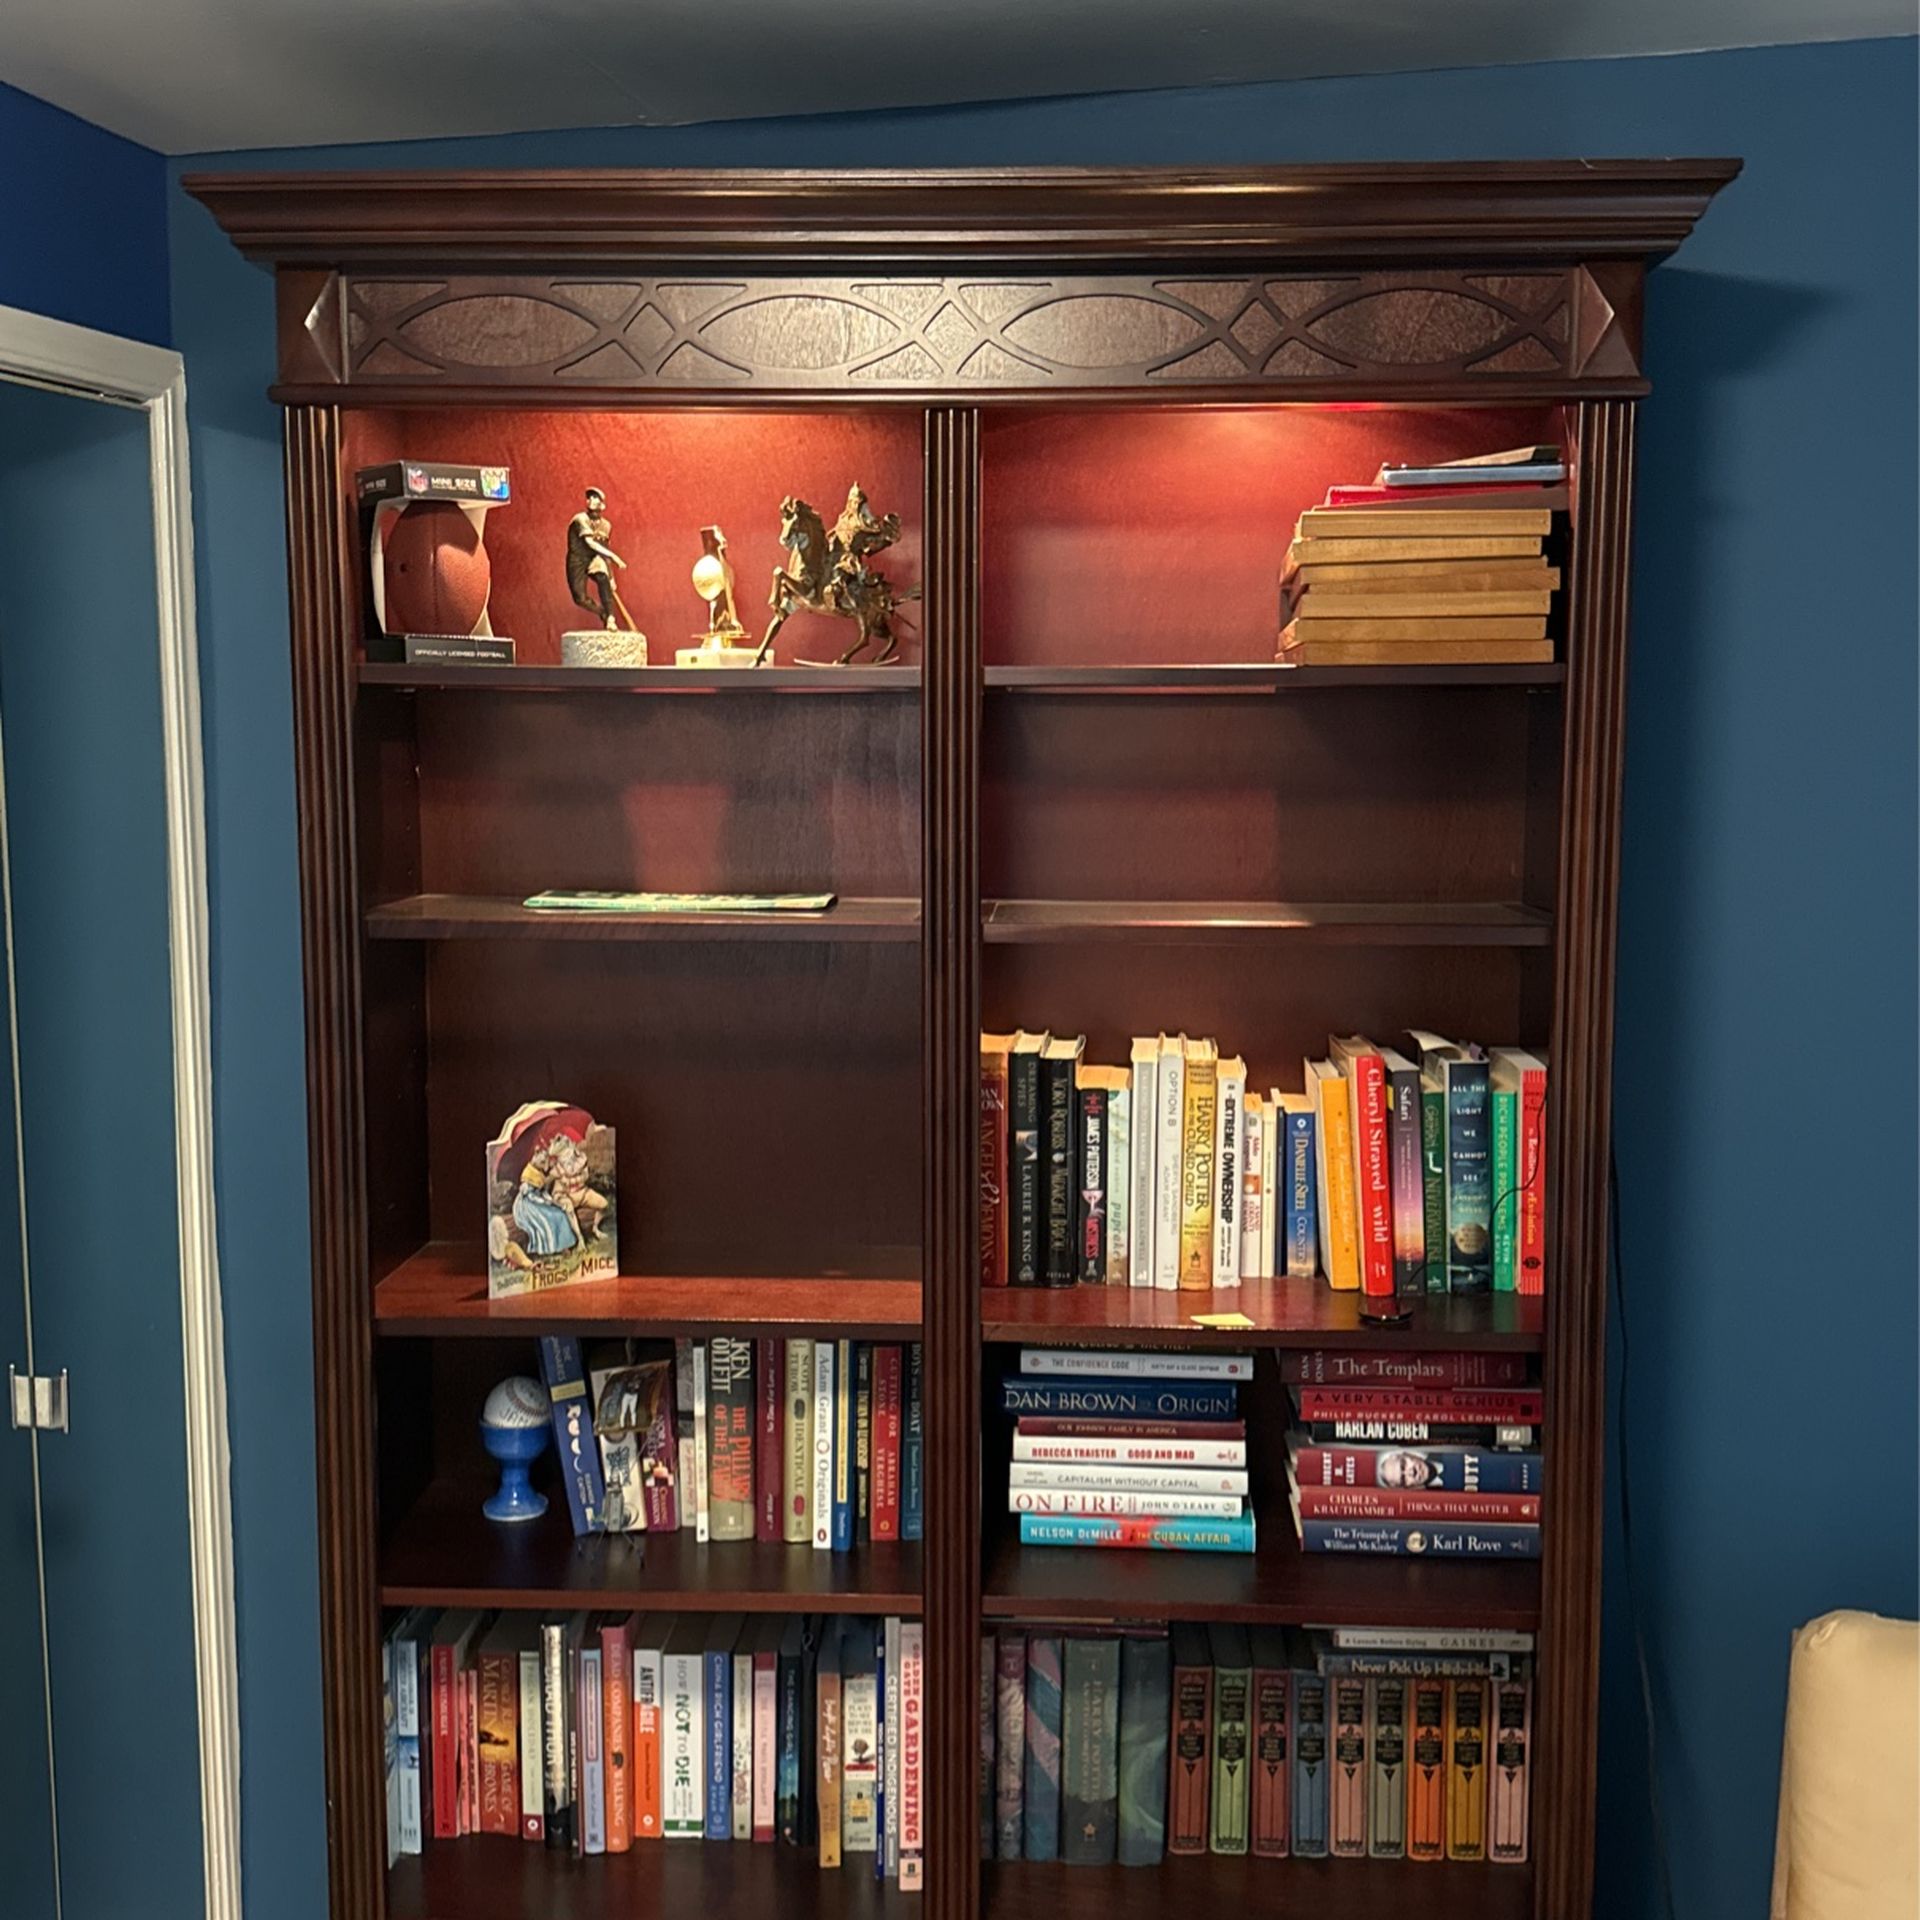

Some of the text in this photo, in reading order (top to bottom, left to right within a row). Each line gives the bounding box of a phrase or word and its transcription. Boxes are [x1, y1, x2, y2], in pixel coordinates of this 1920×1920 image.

[431, 477, 477, 490] MINI SIZE
[1018, 1078, 1026, 1108] SPIES
[1027, 1061, 1037, 1123] DREAMING
[1167, 1070, 1178, 1126] OPTION B
[1400, 1086, 1412, 1121] Safari
[1050, 1077, 1068, 1149] NORA ROBERTS
[1197, 1096, 1213, 1149] HARRY
[1224, 1098, 1236, 1149] EXTREME
[1456, 1107, 1482, 1115] LIGHT
[1366, 1067, 1386, 1192] Cheryl Strayed
[1086, 1115, 1100, 1190] JAMES PATTERSON
[1184, 1128, 1196, 1207] CURSED CHILD
[1497, 1096, 1509, 1231] RICH PEOPLE PROBLEMS
[1195, 1152, 1212, 1212] POTTER
[1221, 1152, 1235, 1224] OWNERSHIP
[1294, 1138, 1310, 1211] DANIELLE STEEL
[1463, 1174, 1478, 1182] SEE
[1022, 1164, 1032, 1262] LAURIE KING
[1373, 1205, 1388, 1243] wild
[1295, 1216, 1308, 1265] COUNTRY
[532, 1266, 569, 1290] FROGS
[731, 1338, 751, 1379] KEN
[790, 1353, 799, 1393] TUROW
[800, 1353, 809, 1392] SCOTT
[1052, 1359, 1130, 1370] THE CONFIDENCE CODE
[1301, 1354, 1309, 1379] DAN
[1332, 1358, 1369, 1375] The
[1372, 1358, 1444, 1382] Templars
[818, 1354, 830, 1434] Adam Grant
[878, 1379, 886, 1417] STONE
[888, 1357, 897, 1438] CUTTING FOR
[910, 1343, 921, 1434] BOYS BOAT
[1005, 1390, 1136, 1411] DAN BROWN
[1158, 1394, 1230, 1415] ORIGIN
[1314, 1394, 1515, 1407] A VERY STABLE GENIUS
[714, 1403, 728, 1450] OF THE
[733, 1406, 747, 1431] THE
[1313, 1410, 1404, 1420] PHILIP RUCKER
[1335, 1421, 1384, 1439] HARLAN
[1387, 1421, 1428, 1440] COBEN
[1415, 1412, 1514, 1423] CAROL LEONNIG
[794, 1421, 805, 1491] IDENTICAL
[1032, 1447, 1116, 1459] REBECCA TRAISTER
[1128, 1449, 1195, 1459] GOOD AND MAD
[1345, 1456, 1355, 1484] GATES
[816, 1459, 829, 1519] Originals
[876, 1447, 885, 1509] VERGHESE
[887, 1450, 895, 1506] ABRAHAM
[1057, 1475, 1112, 1485] CAPITALISM
[1114, 1477, 1158, 1487] WITHOUT
[1161, 1479, 1199, 1488] CAPITAL
[1464, 1453, 1479, 1492] DUTY
[1016, 1494, 1124, 1512] ON FIRE
[1141, 1501, 1217, 1510] JOHN O'LEARY
[1313, 1504, 1394, 1516] KRAUTHAMMER
[1329, 1494, 1379, 1505] CHARLES
[1406, 1502, 1509, 1514] THINGS THAT MATTER
[1030, 1527, 1073, 1538] NELSON
[1154, 1532, 1191, 1542] CUBAN
[1193, 1533, 1231, 1544] AFFAIR
[1323, 1539, 1398, 1554] William McKinley
[1333, 1528, 1400, 1542] The Triumph of
[1433, 1533, 1502, 1551] Karl Rove
[1379, 1638, 1403, 1646] Before
[1440, 1637, 1495, 1647] GAINES
[677, 1659, 687, 1689] HOW
[903, 1661, 911, 1697] GATE
[912, 1643, 920, 1696] GOLDEN
[1351, 1658, 1431, 1677] Never Pick Up
[483, 1658, 500, 1729] MARTIN
[640, 1665, 654, 1734] ANTIFRAGILE
[786, 1688, 795, 1730] DANCING
[674, 1693, 690, 1735] NOT
[713, 1655, 723, 1783] CHINA RICH GIRLFRIEND
[610, 1643, 624, 1827] DEAD COMPANIES WALKING
[677, 1735, 687, 1754] TO
[785, 1733, 794, 1760] GIRLS
[674, 1755, 690, 1788] DIE
[886, 1675, 897, 1834] CERTIFIED INDIGENOUS
[905, 1699, 919, 1843] GARDENING
